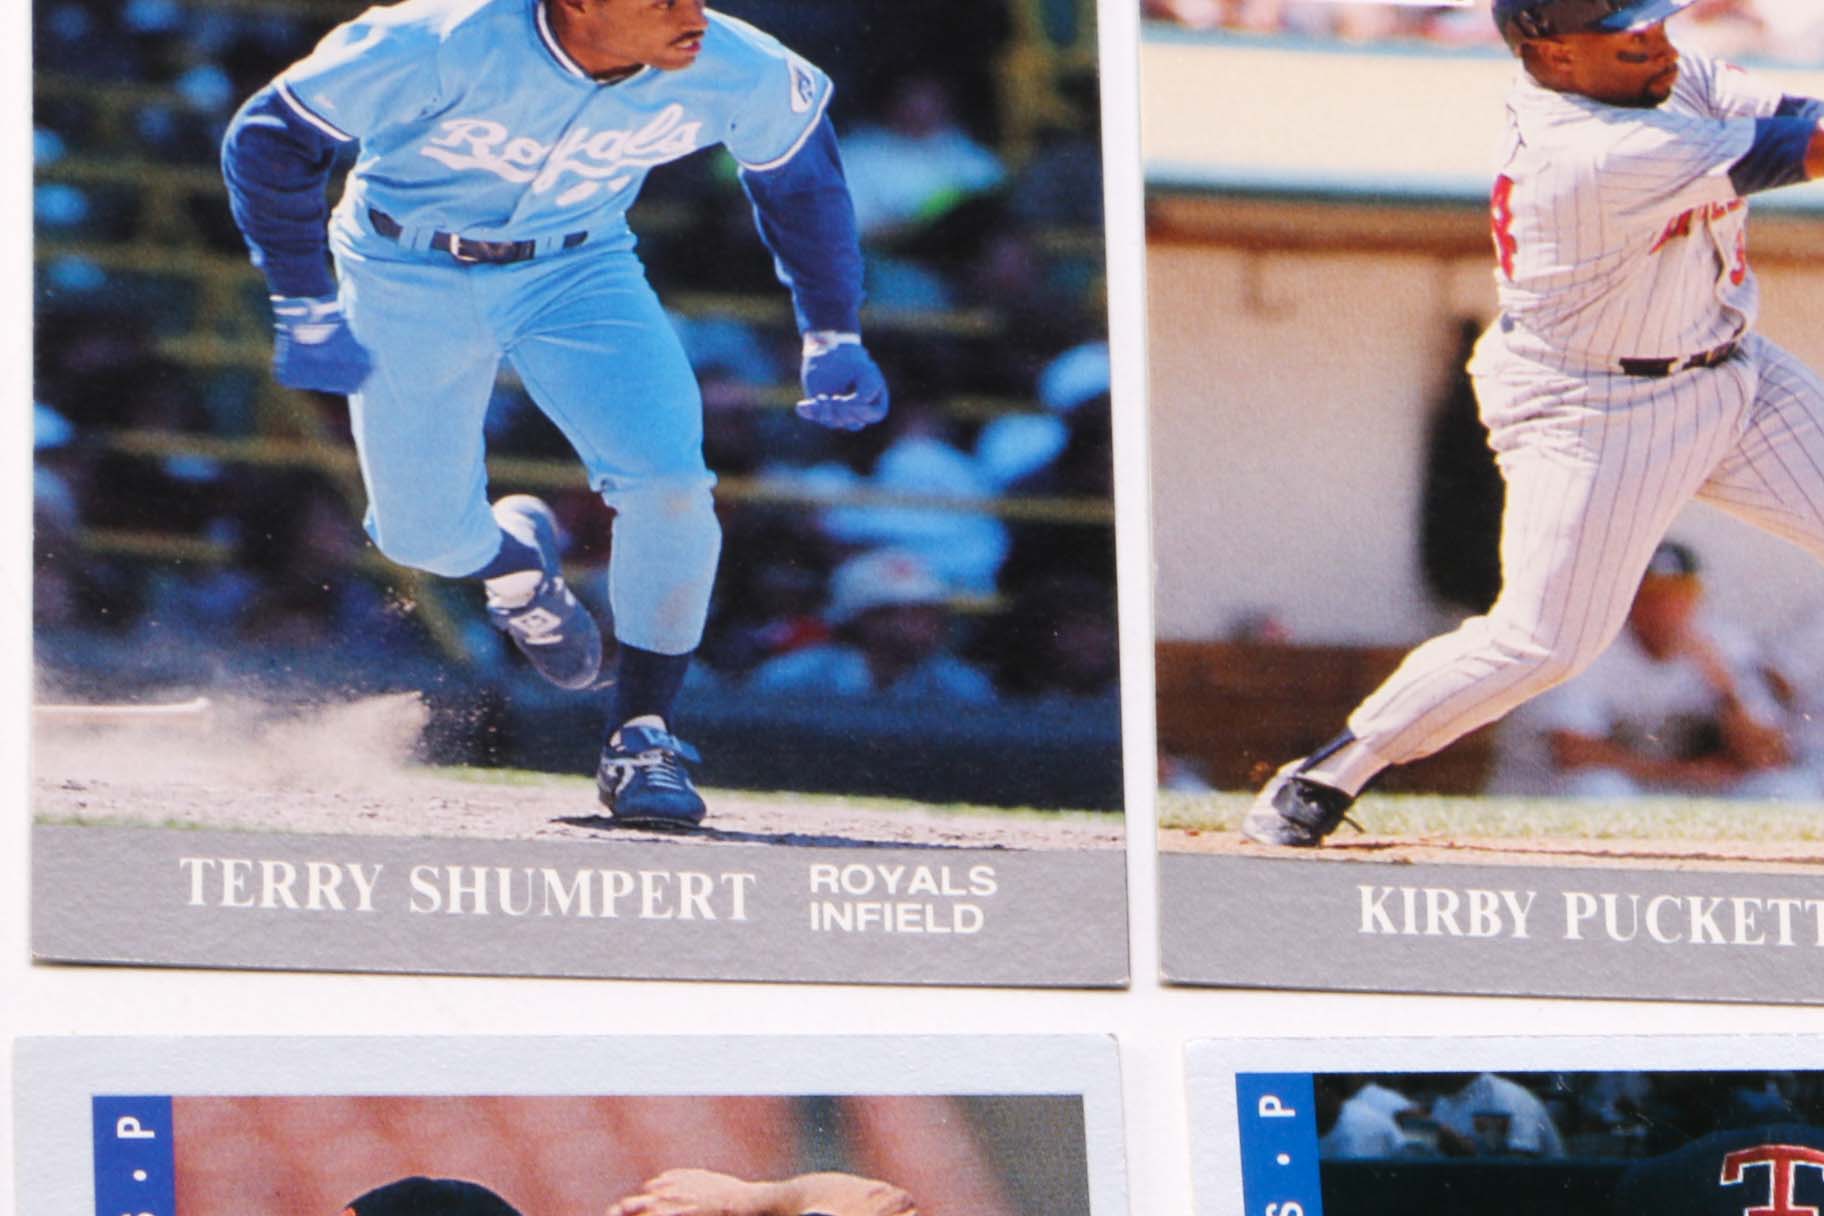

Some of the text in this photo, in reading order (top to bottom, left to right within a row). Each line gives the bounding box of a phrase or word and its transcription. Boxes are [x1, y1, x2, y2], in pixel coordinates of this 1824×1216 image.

[420, 103, 703, 193] Royals
[179, 857, 756, 921] TERRY SHUMPERT
[809, 863, 998, 897] ROYALS
[810, 901, 985, 934] INFIELD
[1357, 885, 1537, 939] KIRBY
[1258, 1094, 1296, 1117] P
[116, 1115, 156, 1139] P
